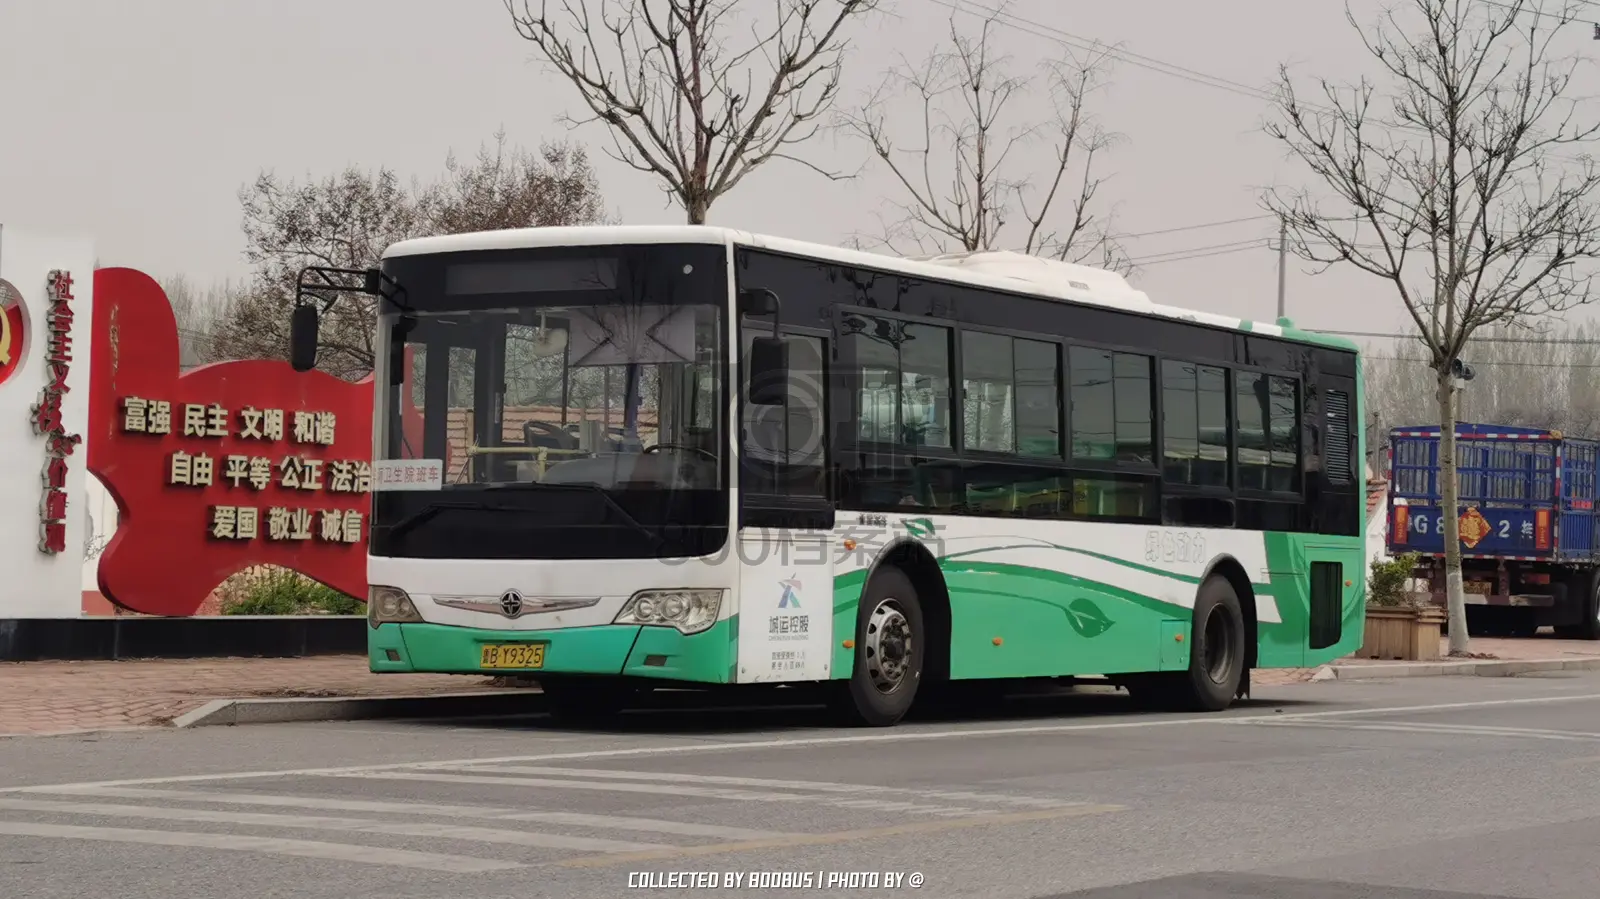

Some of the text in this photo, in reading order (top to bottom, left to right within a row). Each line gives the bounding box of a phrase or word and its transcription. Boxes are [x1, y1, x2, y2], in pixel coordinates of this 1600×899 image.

[124, 396, 336, 444] 富强 民主 文明 和谐
[171, 450, 371, 493] 自由 平等 公正 法治
[213, 505, 363, 542] 爱国 敬业 诚信
